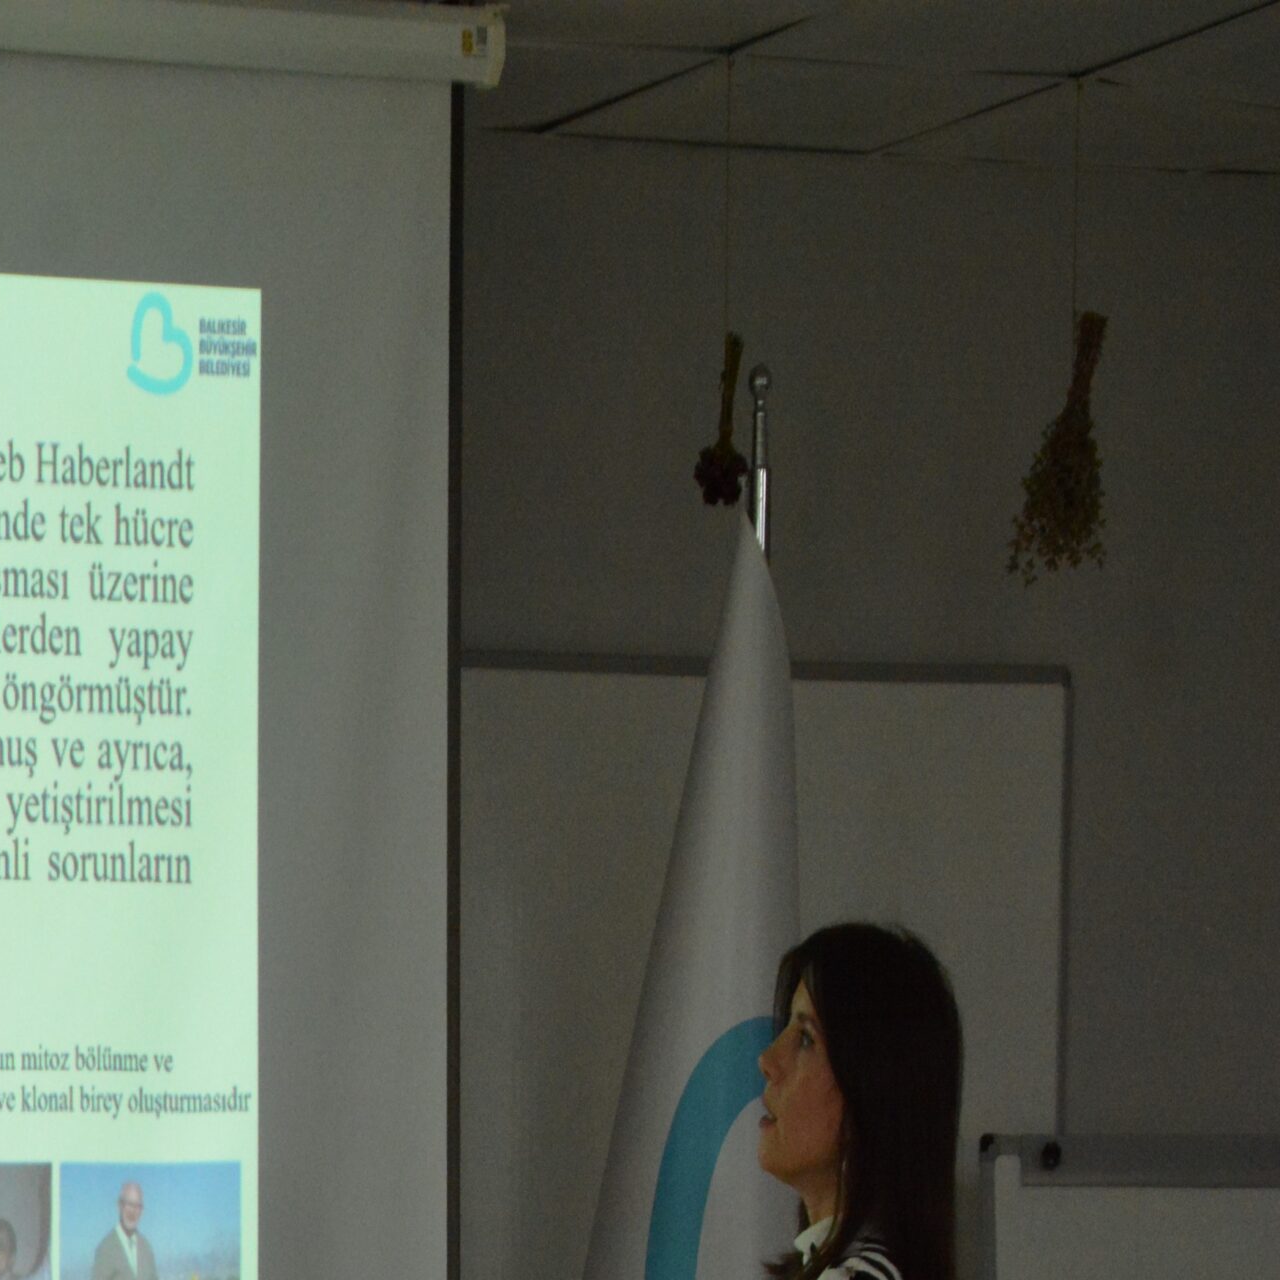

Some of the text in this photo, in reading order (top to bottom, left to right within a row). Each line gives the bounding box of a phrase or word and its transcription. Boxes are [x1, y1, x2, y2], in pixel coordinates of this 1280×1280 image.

[35, 441, 195, 492] Haberlandt
[58, 500, 104, 546] tek
[114, 502, 194, 549] hücre
[88, 559, 194, 605] üzerine
[108, 627, 194, 672] yapay
[2, 672, 192, 726] öngörmüştür.
[51, 737, 85, 770] ve
[97, 739, 193, 780] ayrıca,
[6, 780, 192, 836] yetiştirilmesi
[48, 839, 192, 885] sorunların
[20, 1043, 70, 1072] mitoz
[74, 1044, 149, 1073] bölünme
[153, 1053, 173, 1074] ve
[20, 1084, 75, 1113] klonal
[79, 1084, 124, 1120] birey
[127, 1085, 250, 1119] oluşturmasıdır
